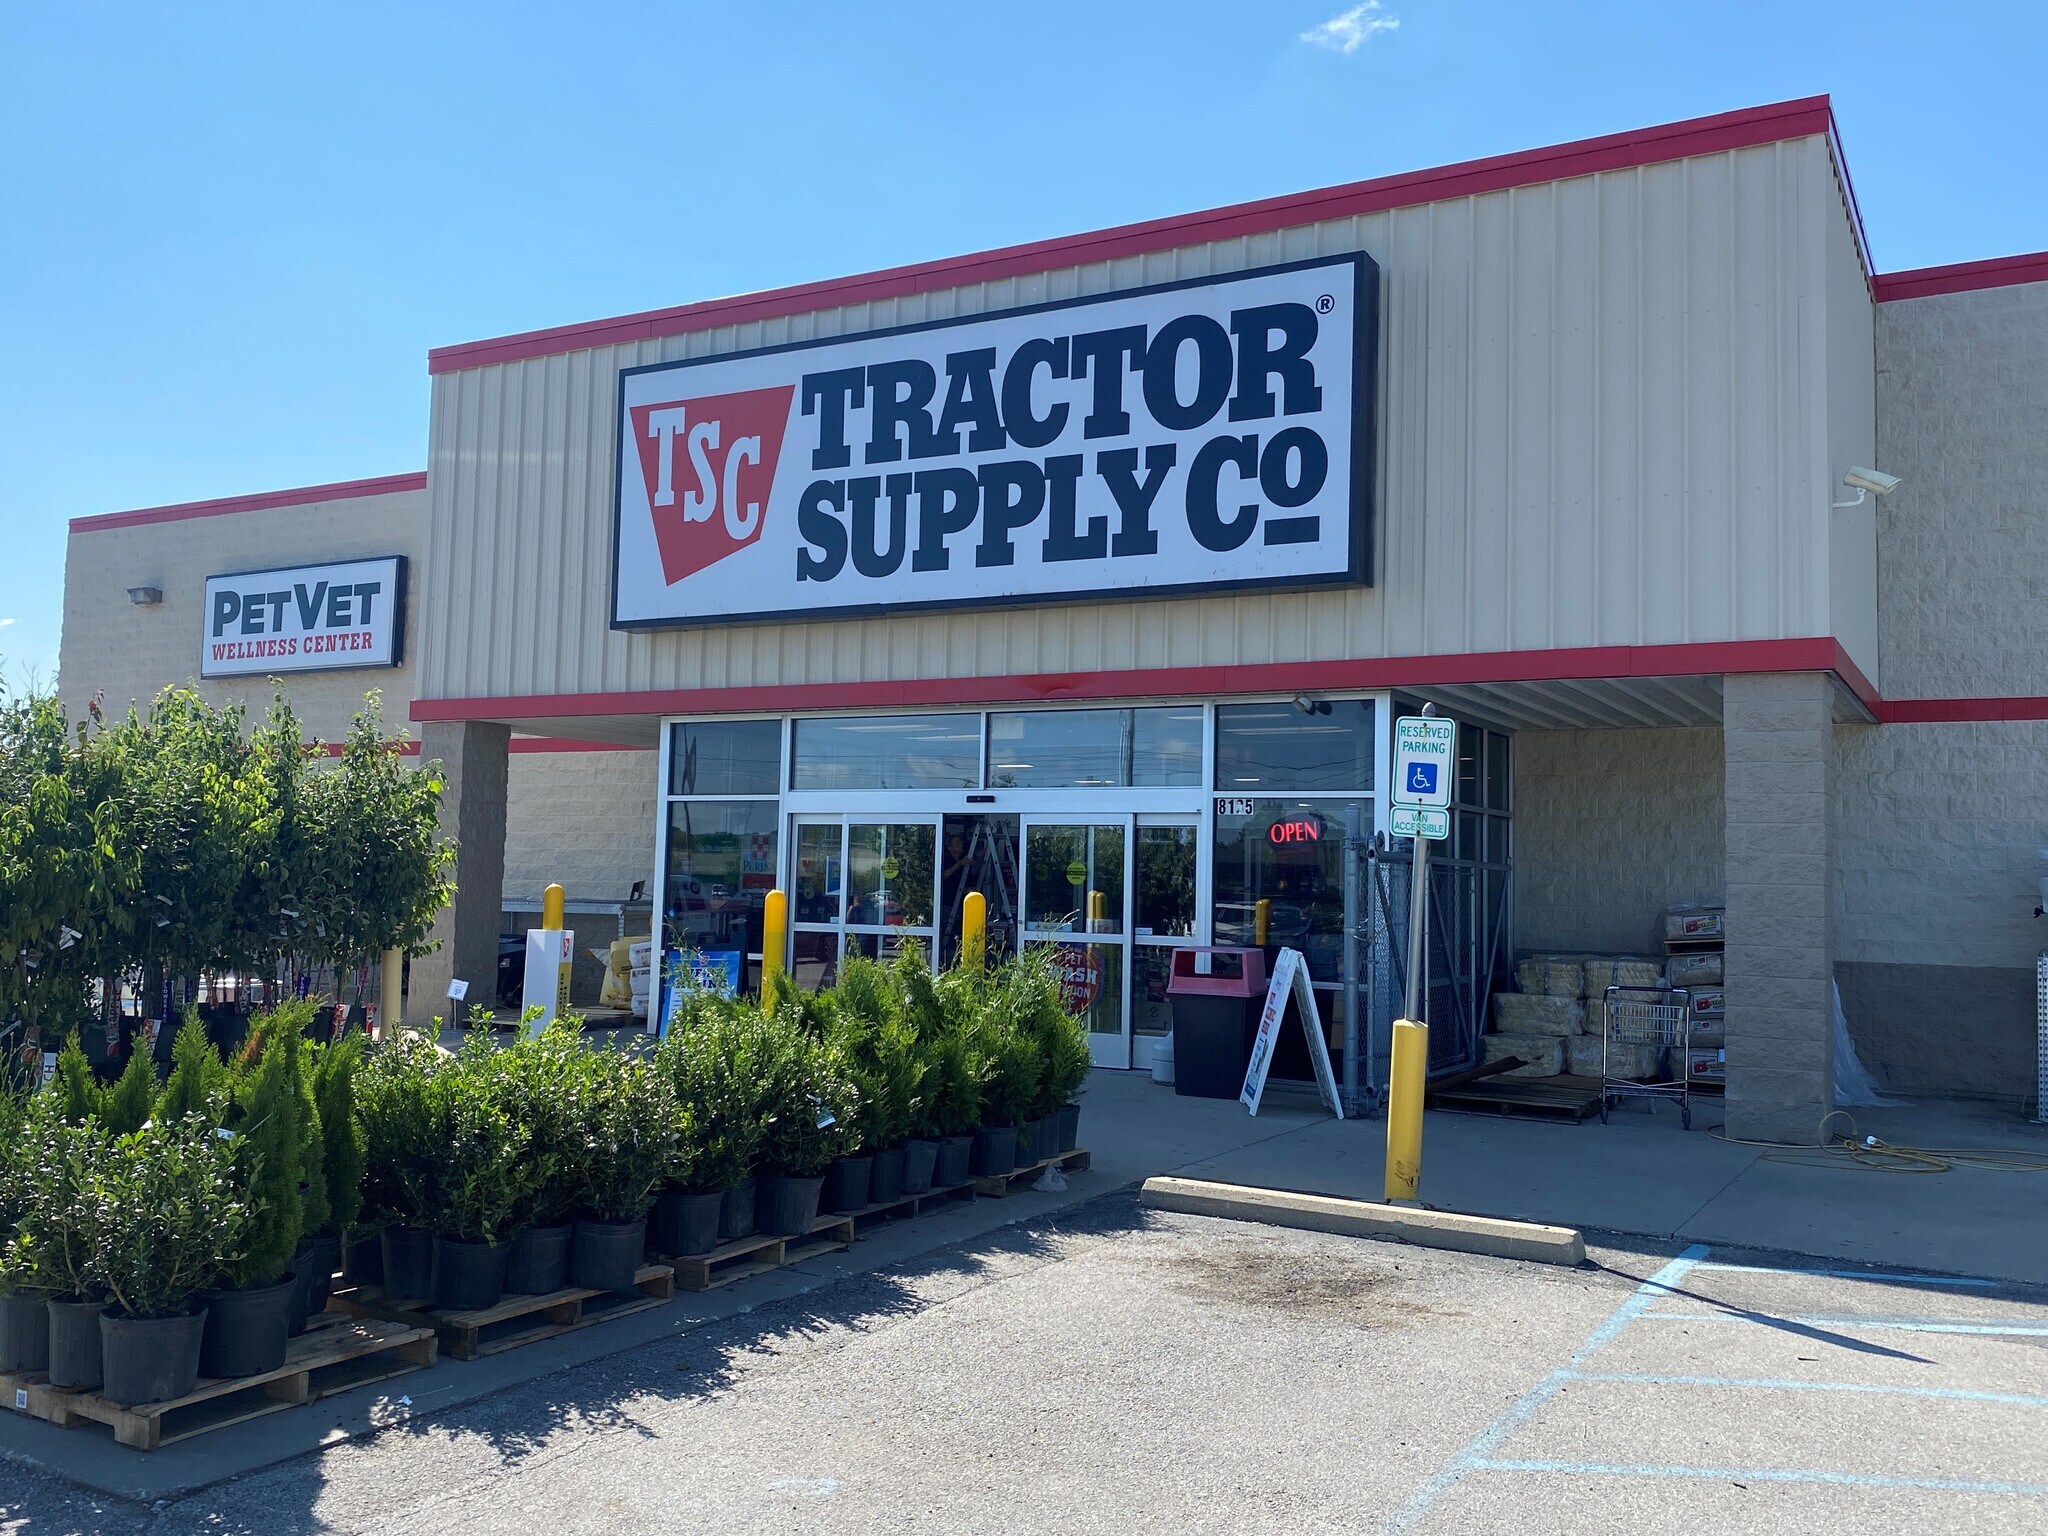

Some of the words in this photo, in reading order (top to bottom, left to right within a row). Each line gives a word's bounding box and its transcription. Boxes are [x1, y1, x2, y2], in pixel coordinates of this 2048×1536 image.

[801, 302, 1323, 470] TRACTOR
[648, 407, 761, 541] TSC
[797, 443, 1176, 582] SUPPLY
[212, 638, 298, 660] WELLNESS
[303, 632, 373, 654] CENTER
[1400, 726, 1450, 738] RESERVED
[1402, 741, 1446, 754] PARKING
[1394, 822, 1444, 833] ACCESSIBLE
[1411, 813, 1428, 823] VAN
[1270, 821, 1318, 844] OPEN
